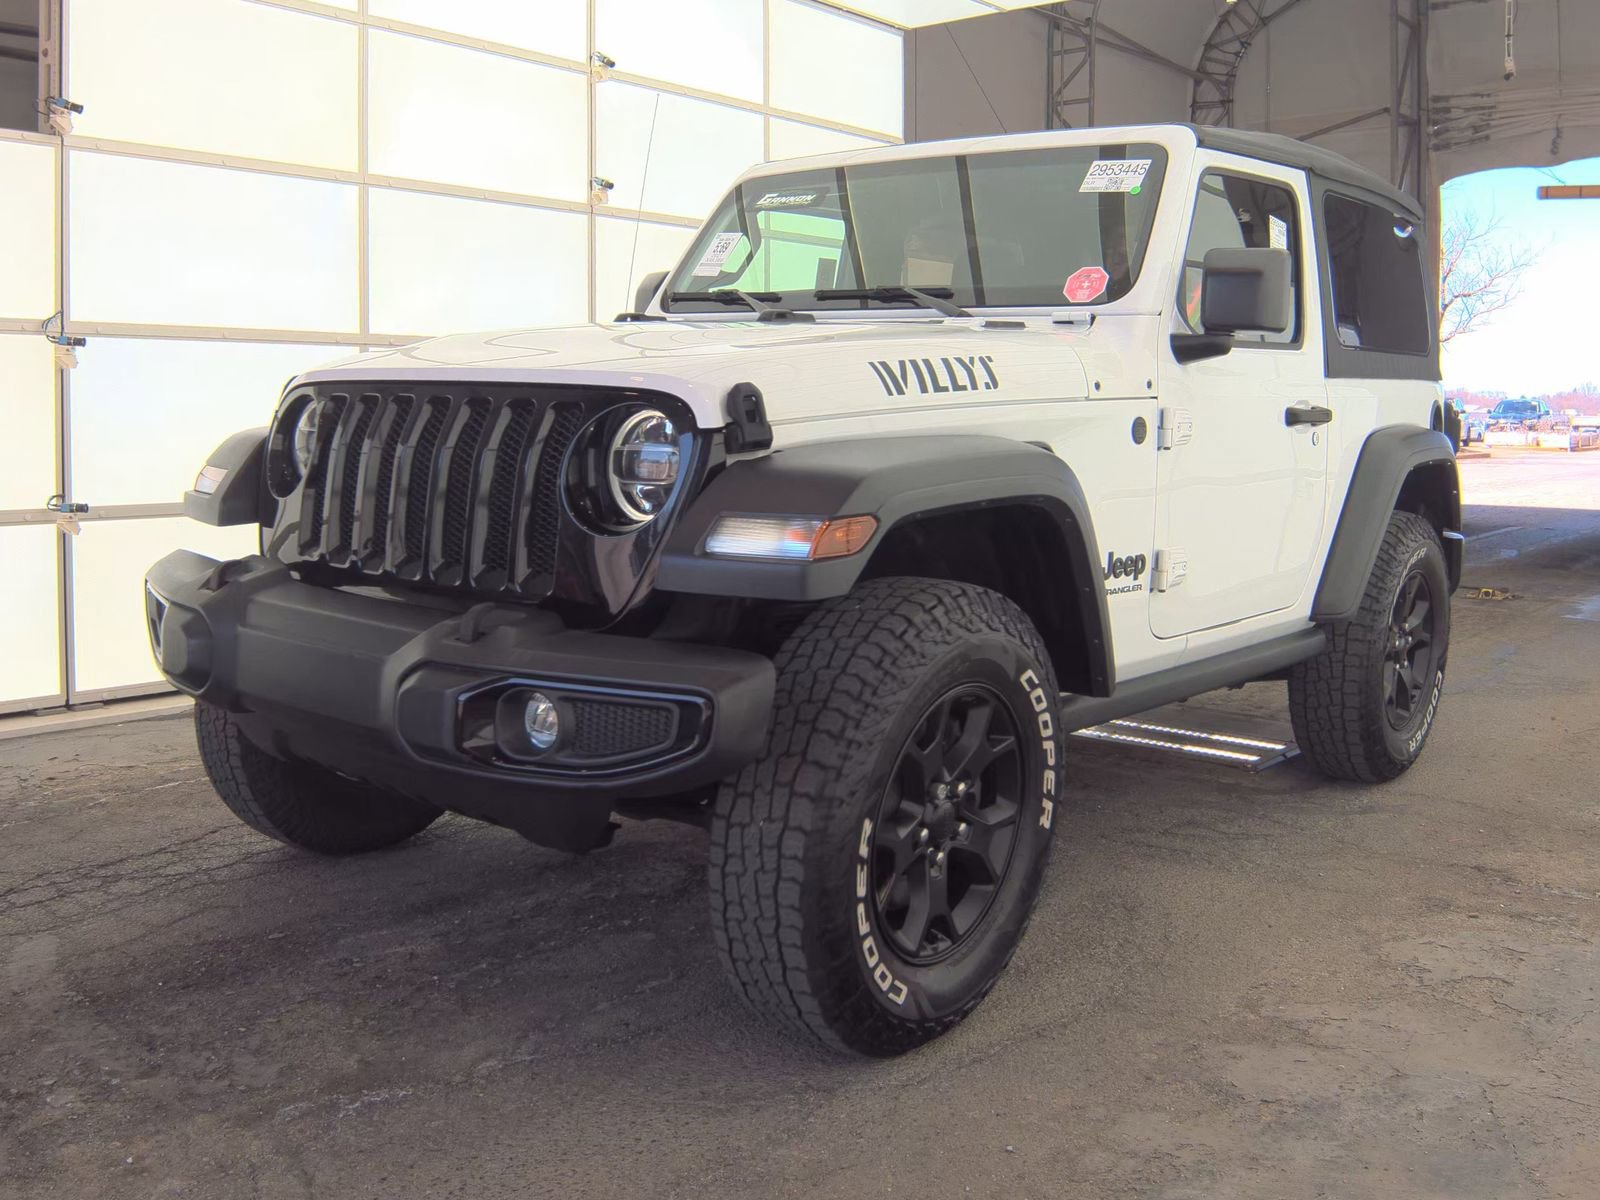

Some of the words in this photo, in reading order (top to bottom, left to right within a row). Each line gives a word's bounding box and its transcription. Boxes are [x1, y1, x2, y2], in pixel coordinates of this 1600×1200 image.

[1089, 163, 1148, 176] 2953445
[867, 355, 999, 397] WILLYS
[1103, 551, 1147, 581] Jeep
[1105, 583, 1143, 596] RANGLER
[1408, 670, 1442, 752] COOPER
[1019, 668, 1058, 830] COOPER
[856, 817, 908, 1006] COOPER
